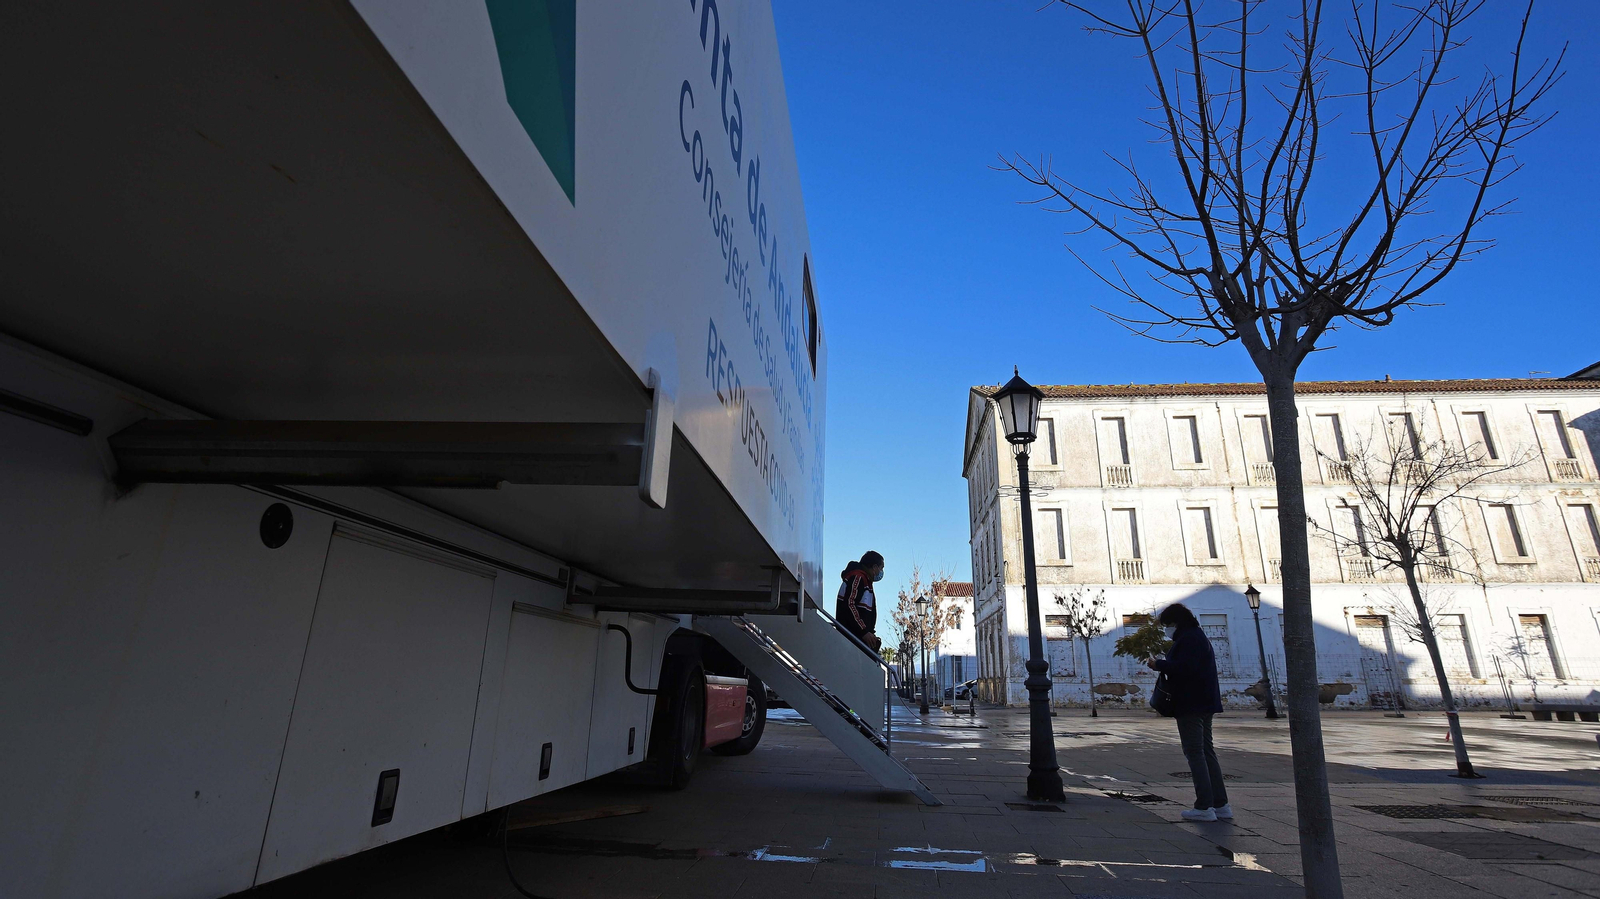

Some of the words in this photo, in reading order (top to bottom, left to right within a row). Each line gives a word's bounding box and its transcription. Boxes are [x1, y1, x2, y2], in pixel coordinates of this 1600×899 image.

[679, 79, 752, 328] Consejería
[752, 303, 764, 362] de
[764, 334, 784, 415] Salud
[690, 0, 743, 179] nta
[747, 152, 767, 268] de
[768, 234, 812, 433] Andalucía
[705, 317, 769, 486] RESPUESTA
